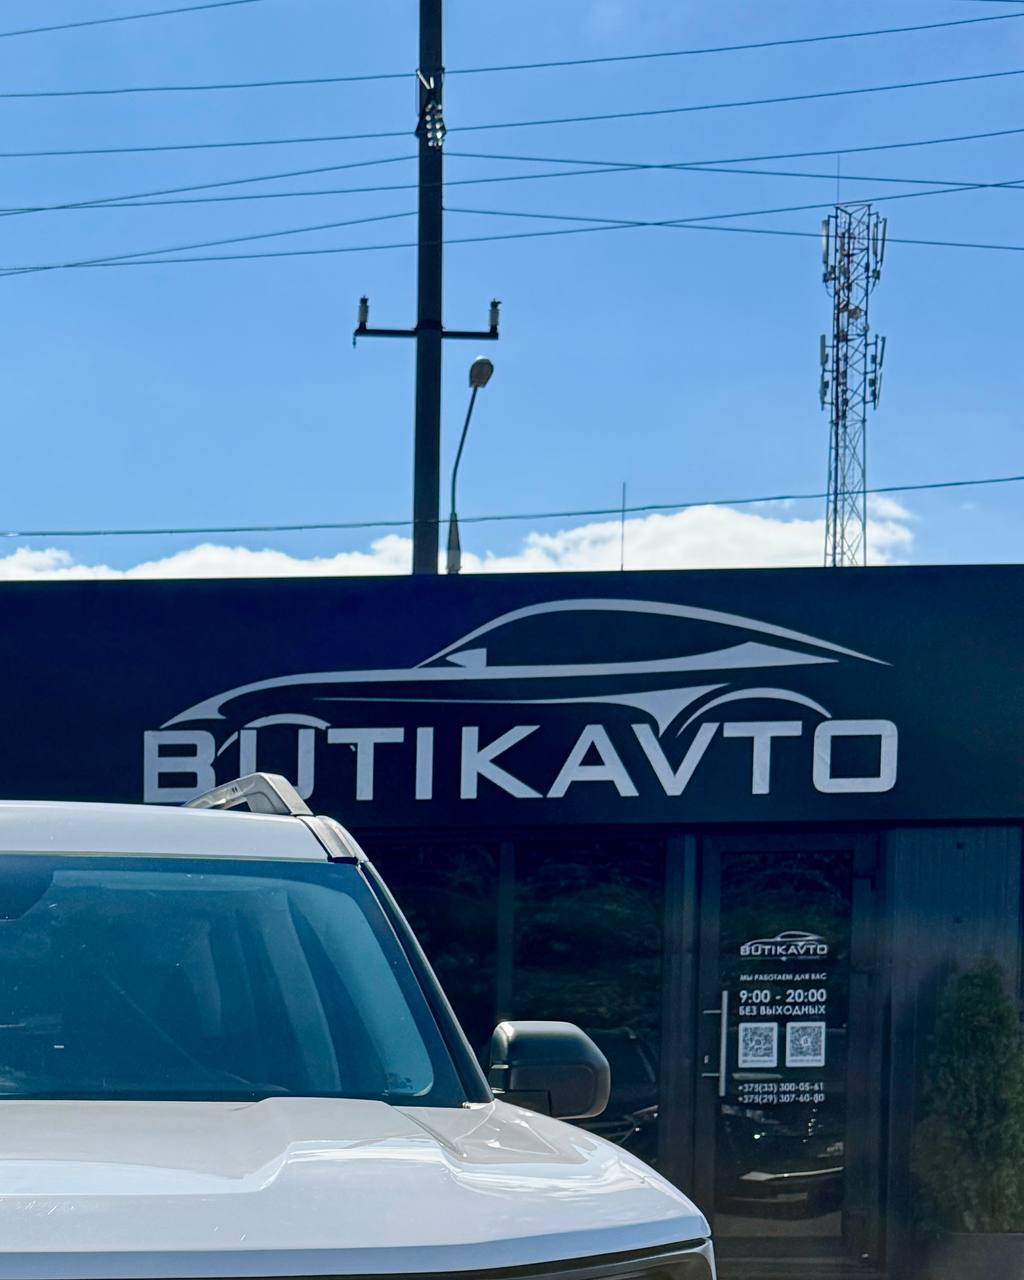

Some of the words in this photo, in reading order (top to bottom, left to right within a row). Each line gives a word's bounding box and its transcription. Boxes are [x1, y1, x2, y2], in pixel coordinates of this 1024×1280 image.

[143, 718, 899, 802] BUTIKAVTO
[740, 944, 828, 955] BUTIKAVTO
[739, 990, 770, 1003] 9:00
[786, 988, 826, 1003] 20:00
[739, 1005, 756, 1016] БЕЗ
[759, 1004, 826, 1016] ВЫХОДНЫХ
